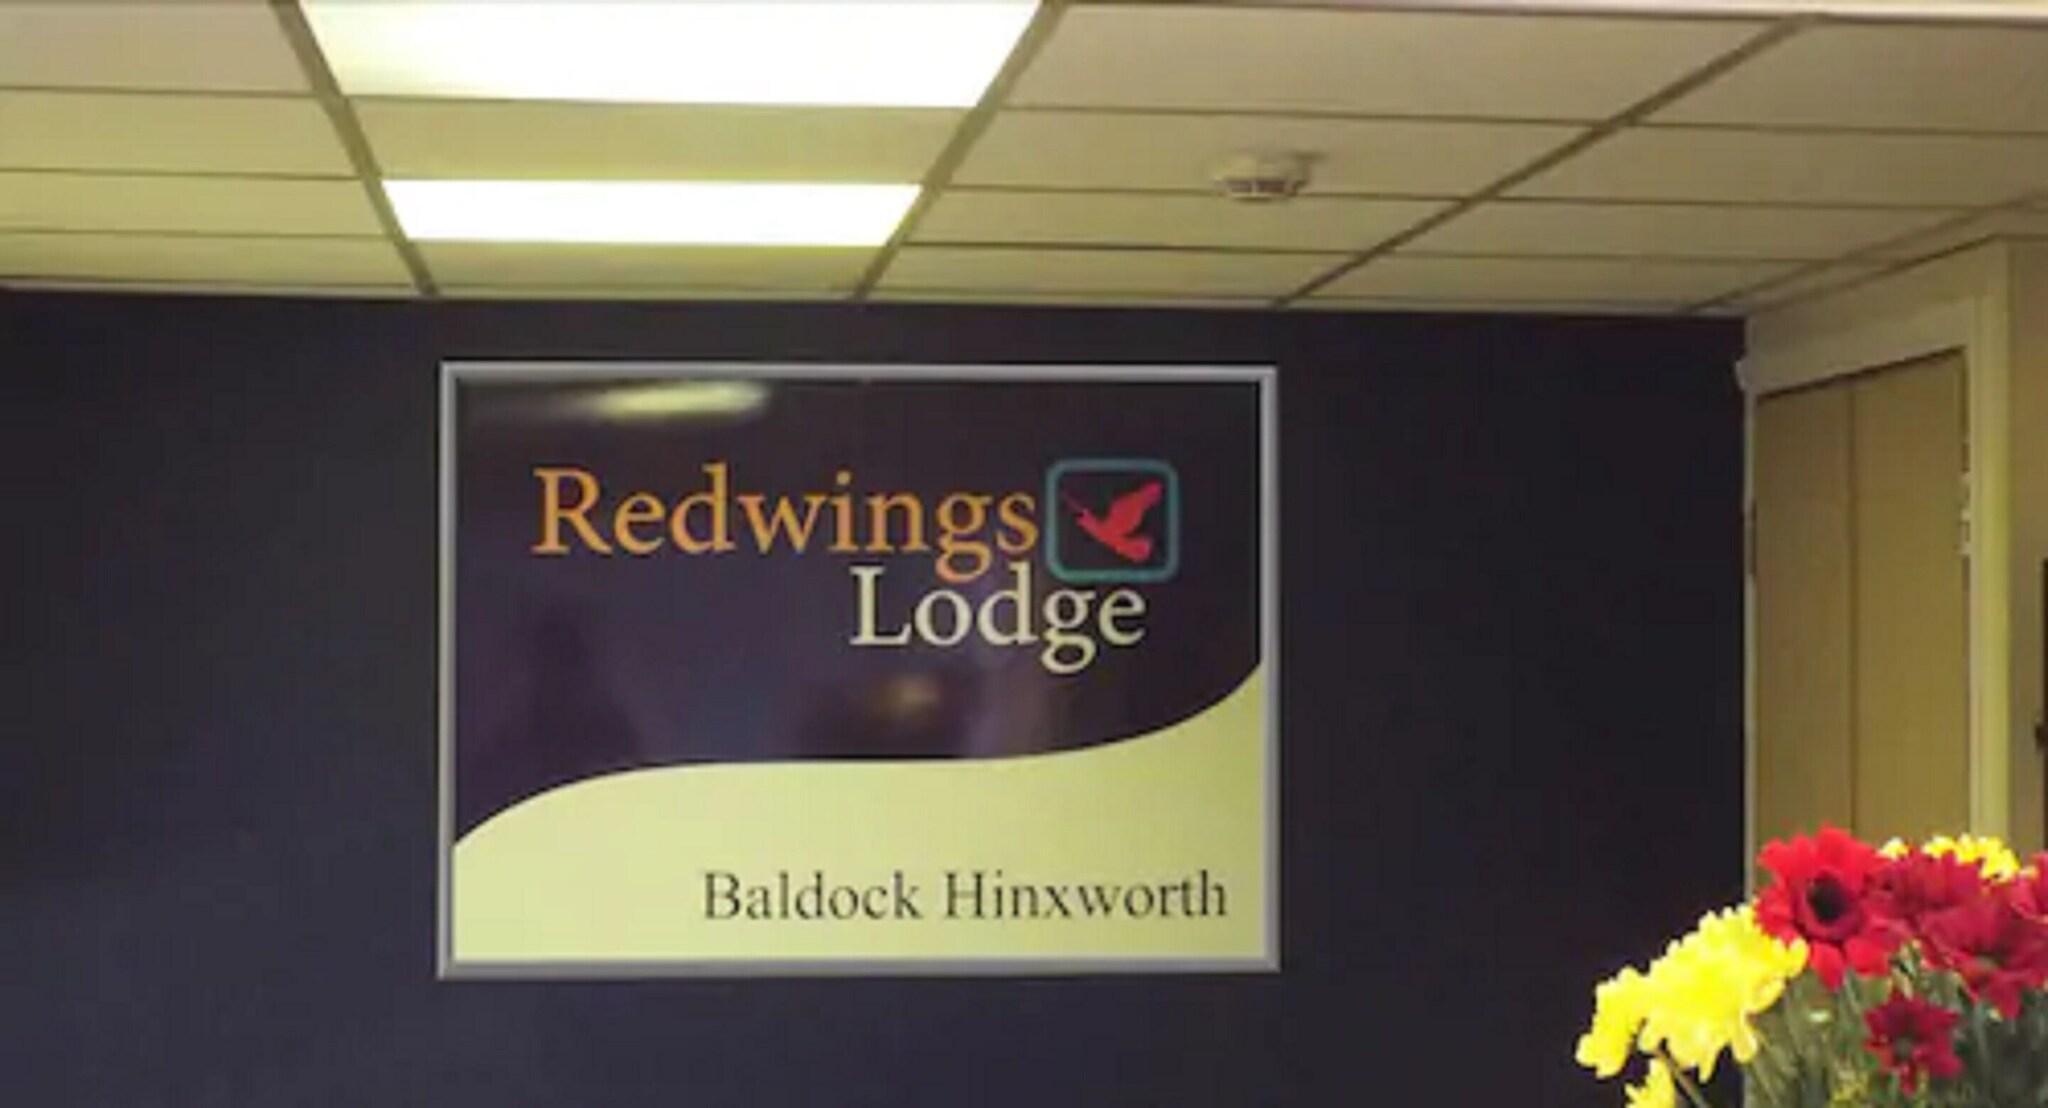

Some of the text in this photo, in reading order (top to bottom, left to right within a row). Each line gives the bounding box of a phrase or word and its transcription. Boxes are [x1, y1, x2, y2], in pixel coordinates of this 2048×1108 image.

[532, 461, 1037, 581] Redwings
[850, 561, 1146, 674] Lodge
[703, 868, 1228, 920] Baldock Hinxworth
